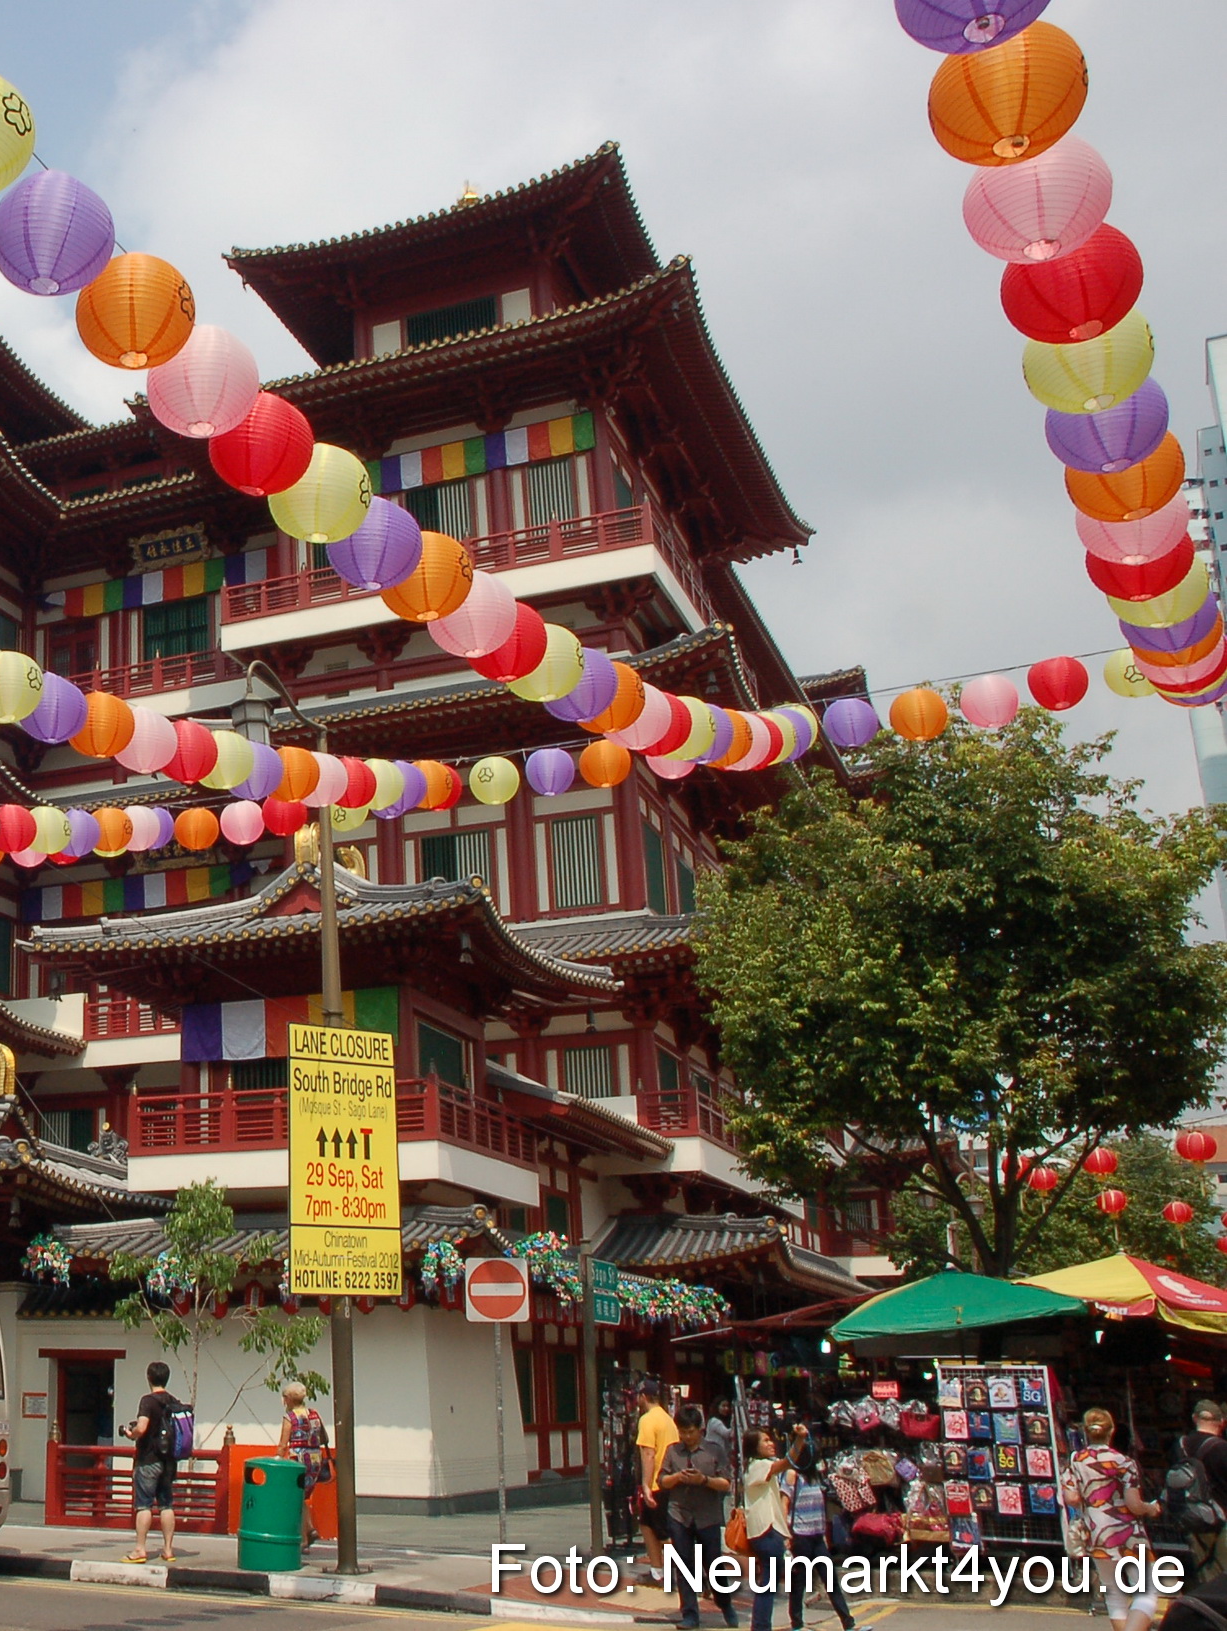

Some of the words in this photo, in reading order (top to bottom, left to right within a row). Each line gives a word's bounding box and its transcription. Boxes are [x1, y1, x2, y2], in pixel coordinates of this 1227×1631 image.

[294, 1029, 326, 1055] LANE
[330, 1034, 389, 1061] CLOSURE
[294, 1067, 329, 1093] South
[333, 1071, 372, 1101] Bridge
[376, 1076, 392, 1098] Rd
[299, 1097, 330, 1116] (Mosque
[332, 1100, 341, 1115] St
[348, 1102, 366, 1121] Sago
[368, 1104, 388, 1120] Lane)
[306, 1162, 324, 1186] 29
[328, 1163, 358, 1193] Sep,
[361, 1165, 384, 1190] Sat
[305, 1195, 332, 1222] 7pm
[342, 1196, 386, 1223] 8:30pm
[324, 1230, 368, 1249] Chinatown
[294, 1251, 345, 1268] Mid-Autumn
[347, 1251, 377, 1268] Festival
[379, 1252, 399, 1269] 2012
[294, 1269, 342, 1289] HOTLINE:
[345, 1271, 371, 1290] 6222
[374, 1272, 399, 1290] 3597
[1023, 1391, 1042, 1402] SG
[999, 1457, 1015, 1468] SG
